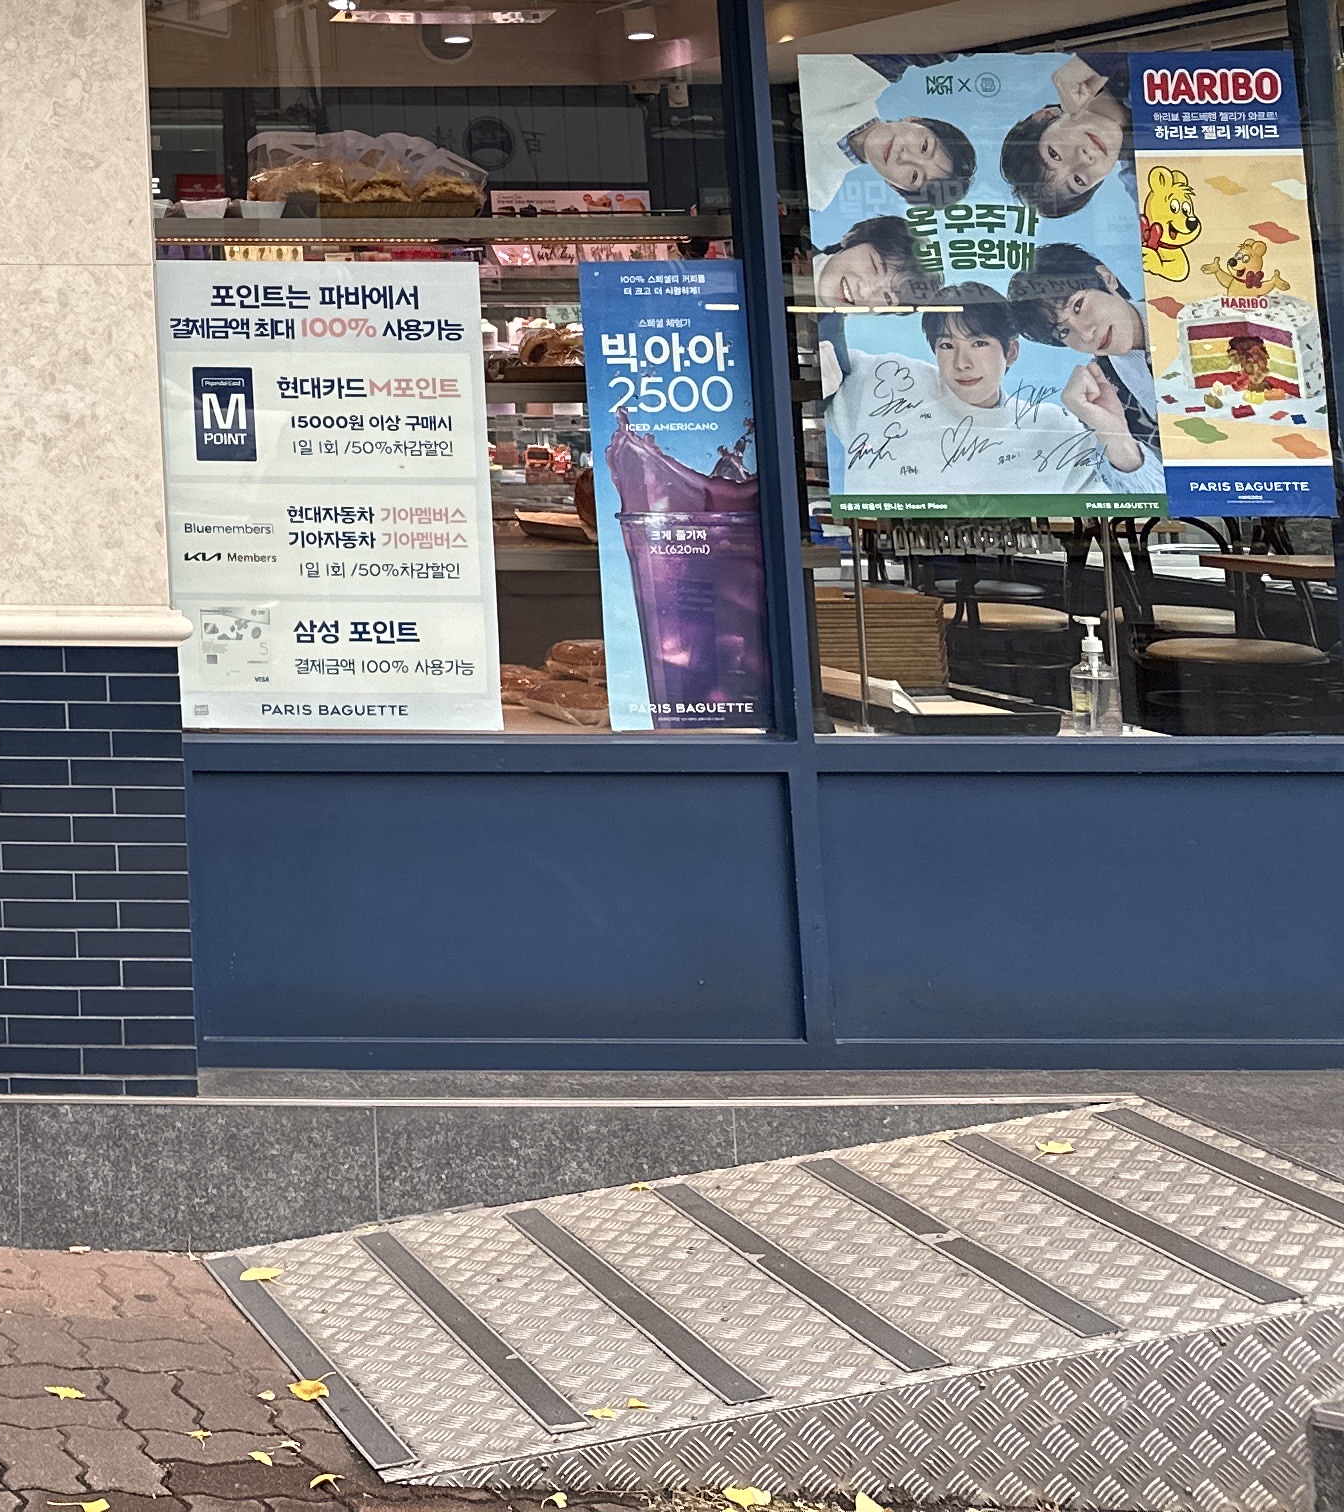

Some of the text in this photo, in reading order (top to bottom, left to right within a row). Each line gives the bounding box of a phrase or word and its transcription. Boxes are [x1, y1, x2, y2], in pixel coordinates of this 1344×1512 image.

[1144, 68, 1282, 105] HARIBO
[1155, 125, 1280, 140] 하리보 젤리 케이크
[906, 204, 1039, 237] 온 우주가
[948, 239, 1036, 272] 응원해
[211, 284, 419, 310] 포인트는 파바에서
[1220, 296, 1269, 310] HARIBO
[170, 317, 465, 341] 결제금액 최대 100% 사용가능
[607, 375, 734, 413] 2500
[202, 393, 247, 429] M
[290, 414, 453, 432] 15000원 이상 구매시
[626, 422, 718, 431] ICED AMERICANO
[204, 432, 248, 445] POINT
[1190, 481, 1311, 492] PARIS BAGUETTE
[287, 505, 468, 524] 현대자동차 기아멤버스
[1086, 501, 1160, 510] PARIS BAGUETTE
[184, 522, 273, 536] Bluemembers
[650, 529, 708, 541] 크게 즐기자
[288, 530, 469, 549] 기아자동차 기아멤버스
[227, 551, 277, 564] Members
[292, 620, 421, 644] 삼성 포인트
[294, 658, 476, 676] 결제금액 100% 사용가능
[261, 704, 409, 717] PARIS BAGUETTE
[629, 702, 754, 714] PARIS BAGUETTE
